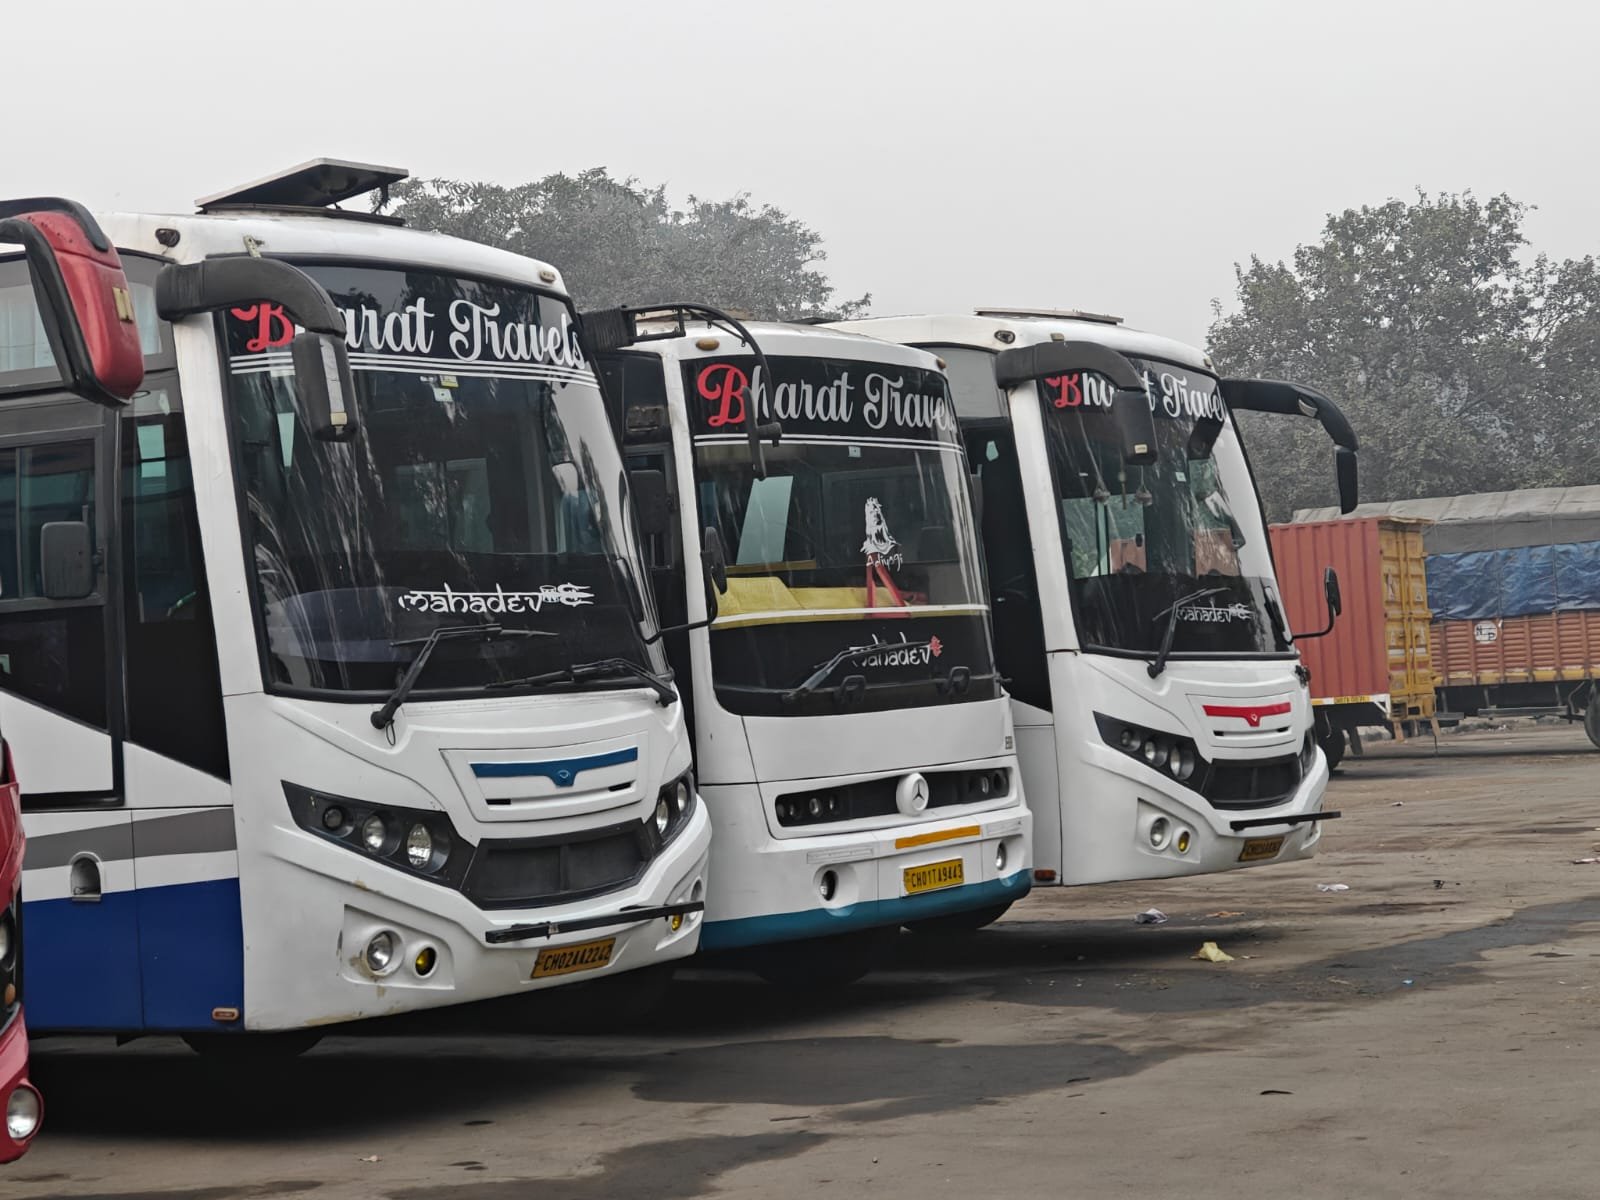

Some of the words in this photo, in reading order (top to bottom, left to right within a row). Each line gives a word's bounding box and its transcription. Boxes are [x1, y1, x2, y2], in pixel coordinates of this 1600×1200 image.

[231, 297, 435, 353] Barat
[448, 299, 585, 369] Travels
[697, 363, 855, 427] Bharat
